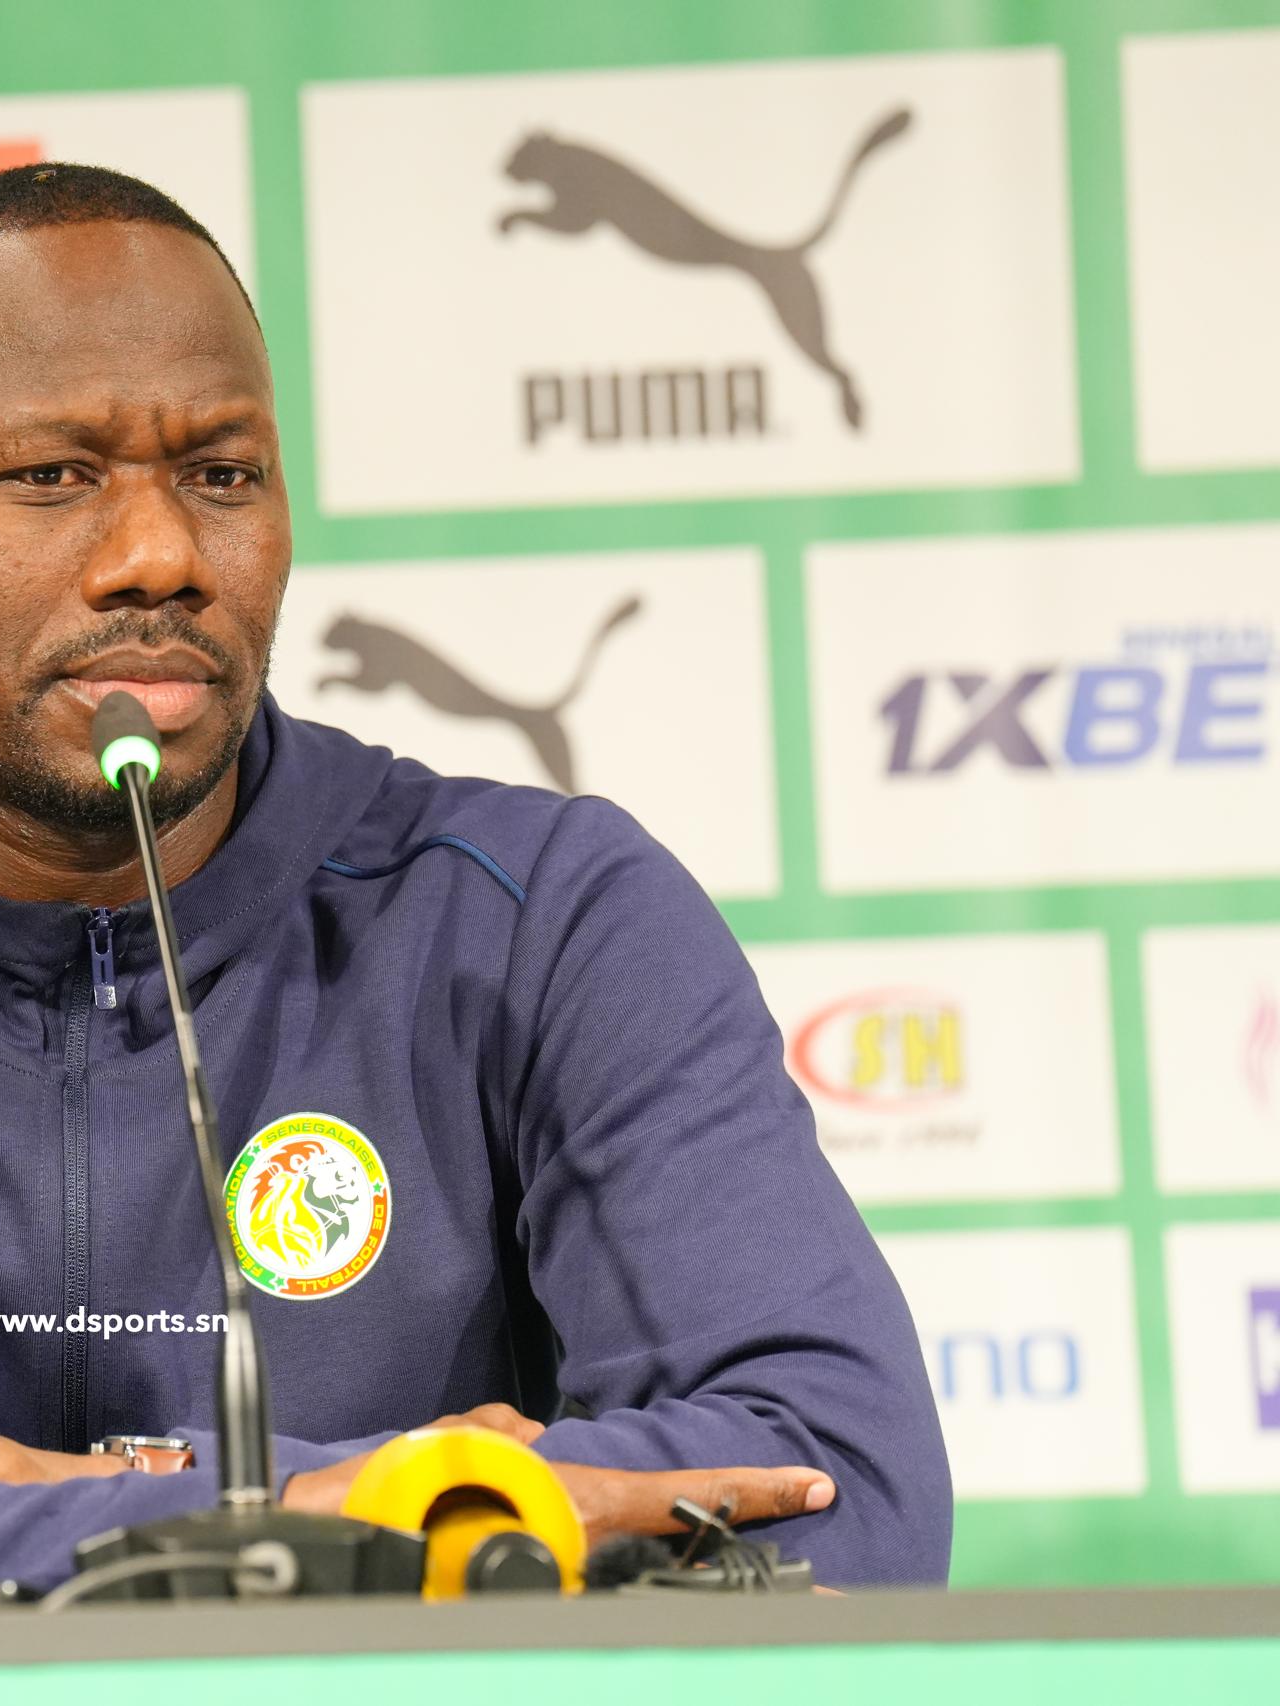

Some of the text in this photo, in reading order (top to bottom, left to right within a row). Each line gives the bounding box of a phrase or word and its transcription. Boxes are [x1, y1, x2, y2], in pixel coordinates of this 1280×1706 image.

[523, 367, 766, 444] PUMA
[878, 662, 1271, 774] 1XBE
[372, 1204, 385, 1230] DE
[296, 1235, 379, 1292] FOOTBALL
[938, 1332, 1081, 1400] no
